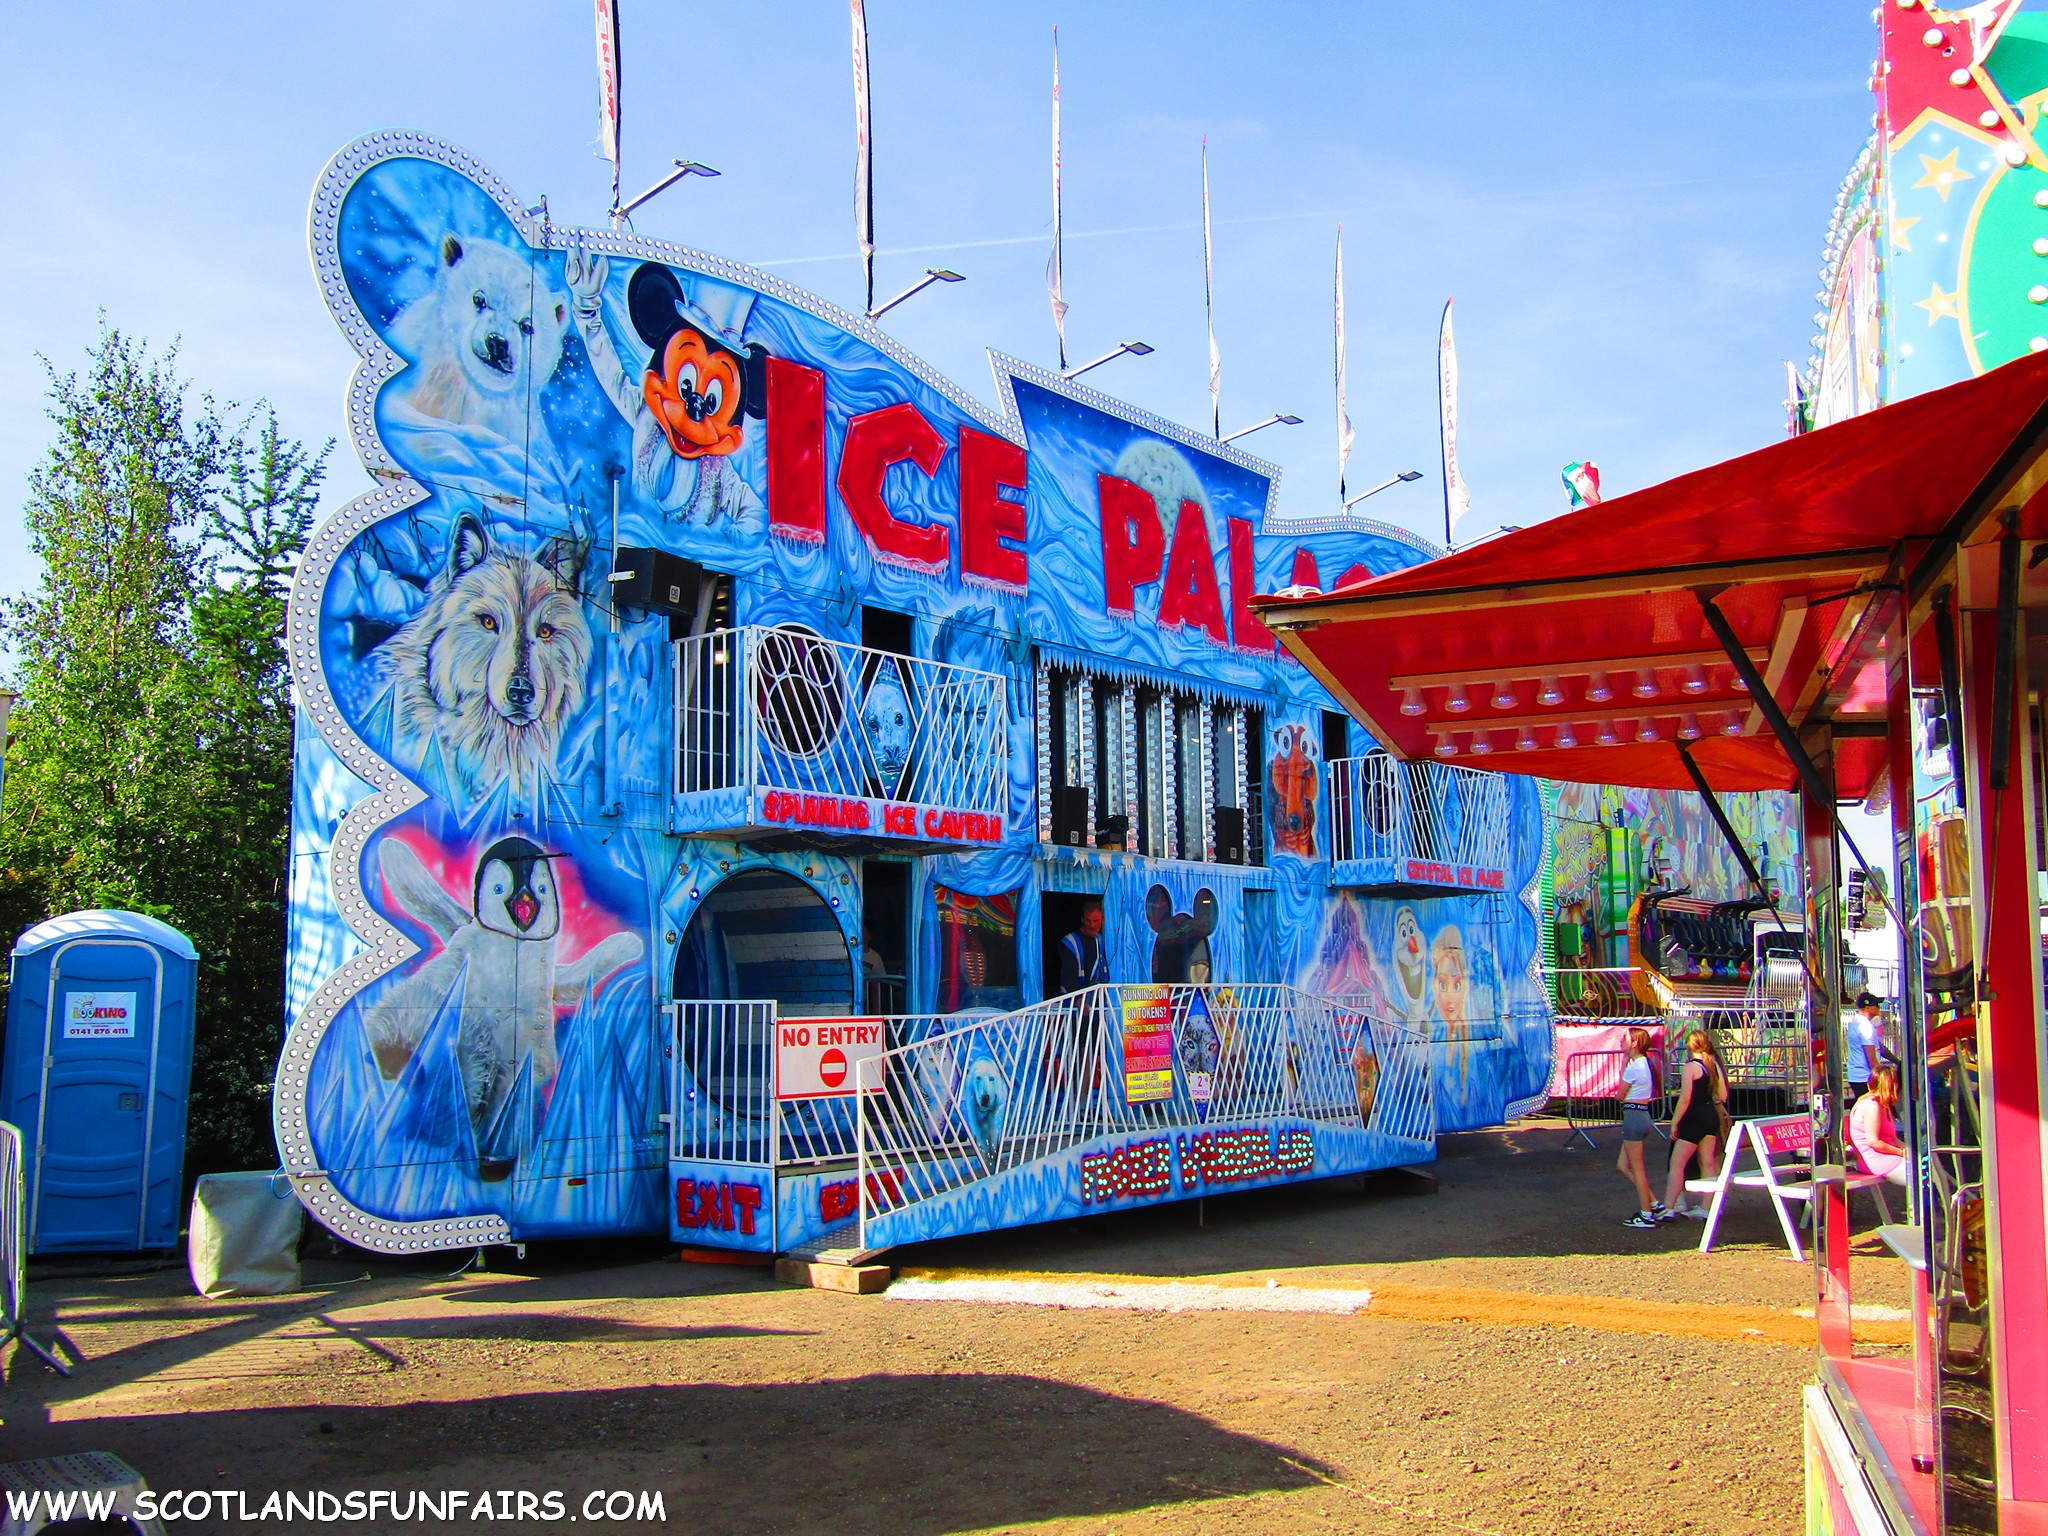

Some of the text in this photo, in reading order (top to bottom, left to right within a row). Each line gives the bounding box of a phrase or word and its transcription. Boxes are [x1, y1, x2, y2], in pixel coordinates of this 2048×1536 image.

[766, 355, 1028, 597] ICE
[763, 791, 1002, 842] SPINNING ICE CAVERN
[1123, 987, 1169, 1001] RUNNING LOW
[72, 1007, 127, 1019] LOOKING
[1126, 1006, 1167, 1020] ON TOKENS?
[783, 1026, 880, 1047] NO ENTRY
[1127, 1035, 1170, 1051] TWISTER
[1197, 1075, 1203, 1087] 2
[1775, 1124, 1798, 1139] HAVE
[1081, 1140, 1170, 1203] FROZEN
[677, 1179, 761, 1234] EXIT
